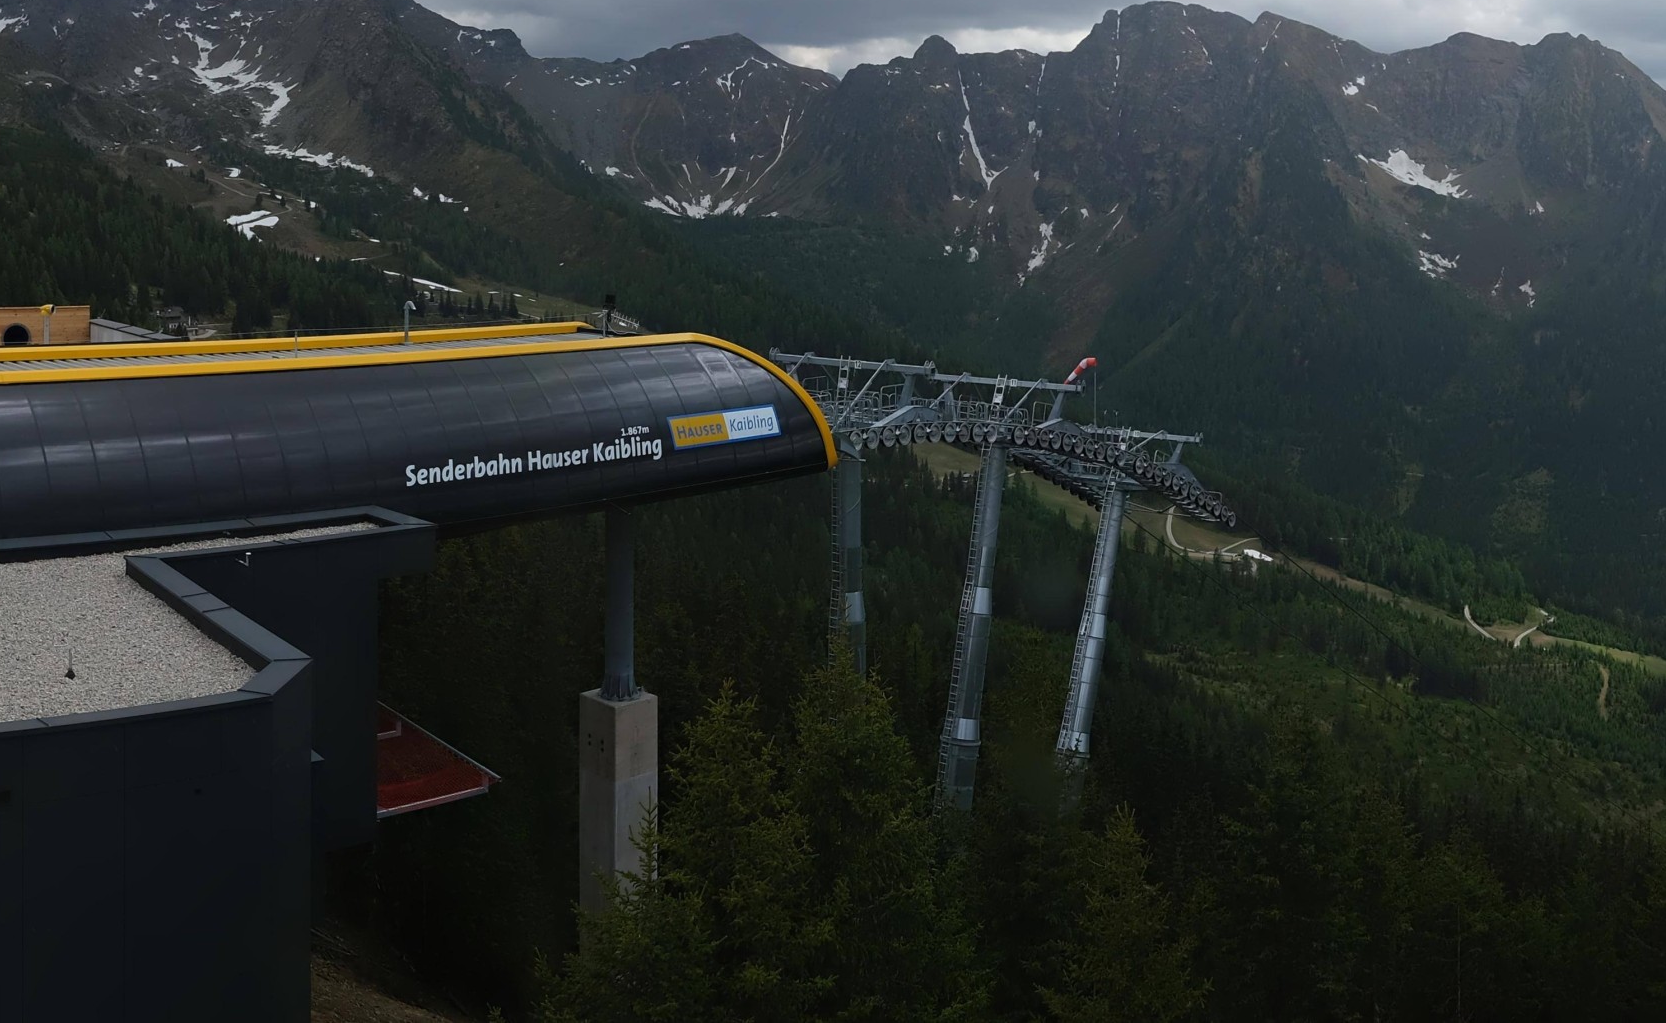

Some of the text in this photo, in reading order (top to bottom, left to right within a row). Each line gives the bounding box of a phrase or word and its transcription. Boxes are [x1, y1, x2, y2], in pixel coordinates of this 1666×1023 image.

[620, 425, 650, 437] 1.867m
[676, 415, 774, 439] HAUSER Kaibling
[405, 436, 663, 487] Senderbahn Hauser Kaibling
